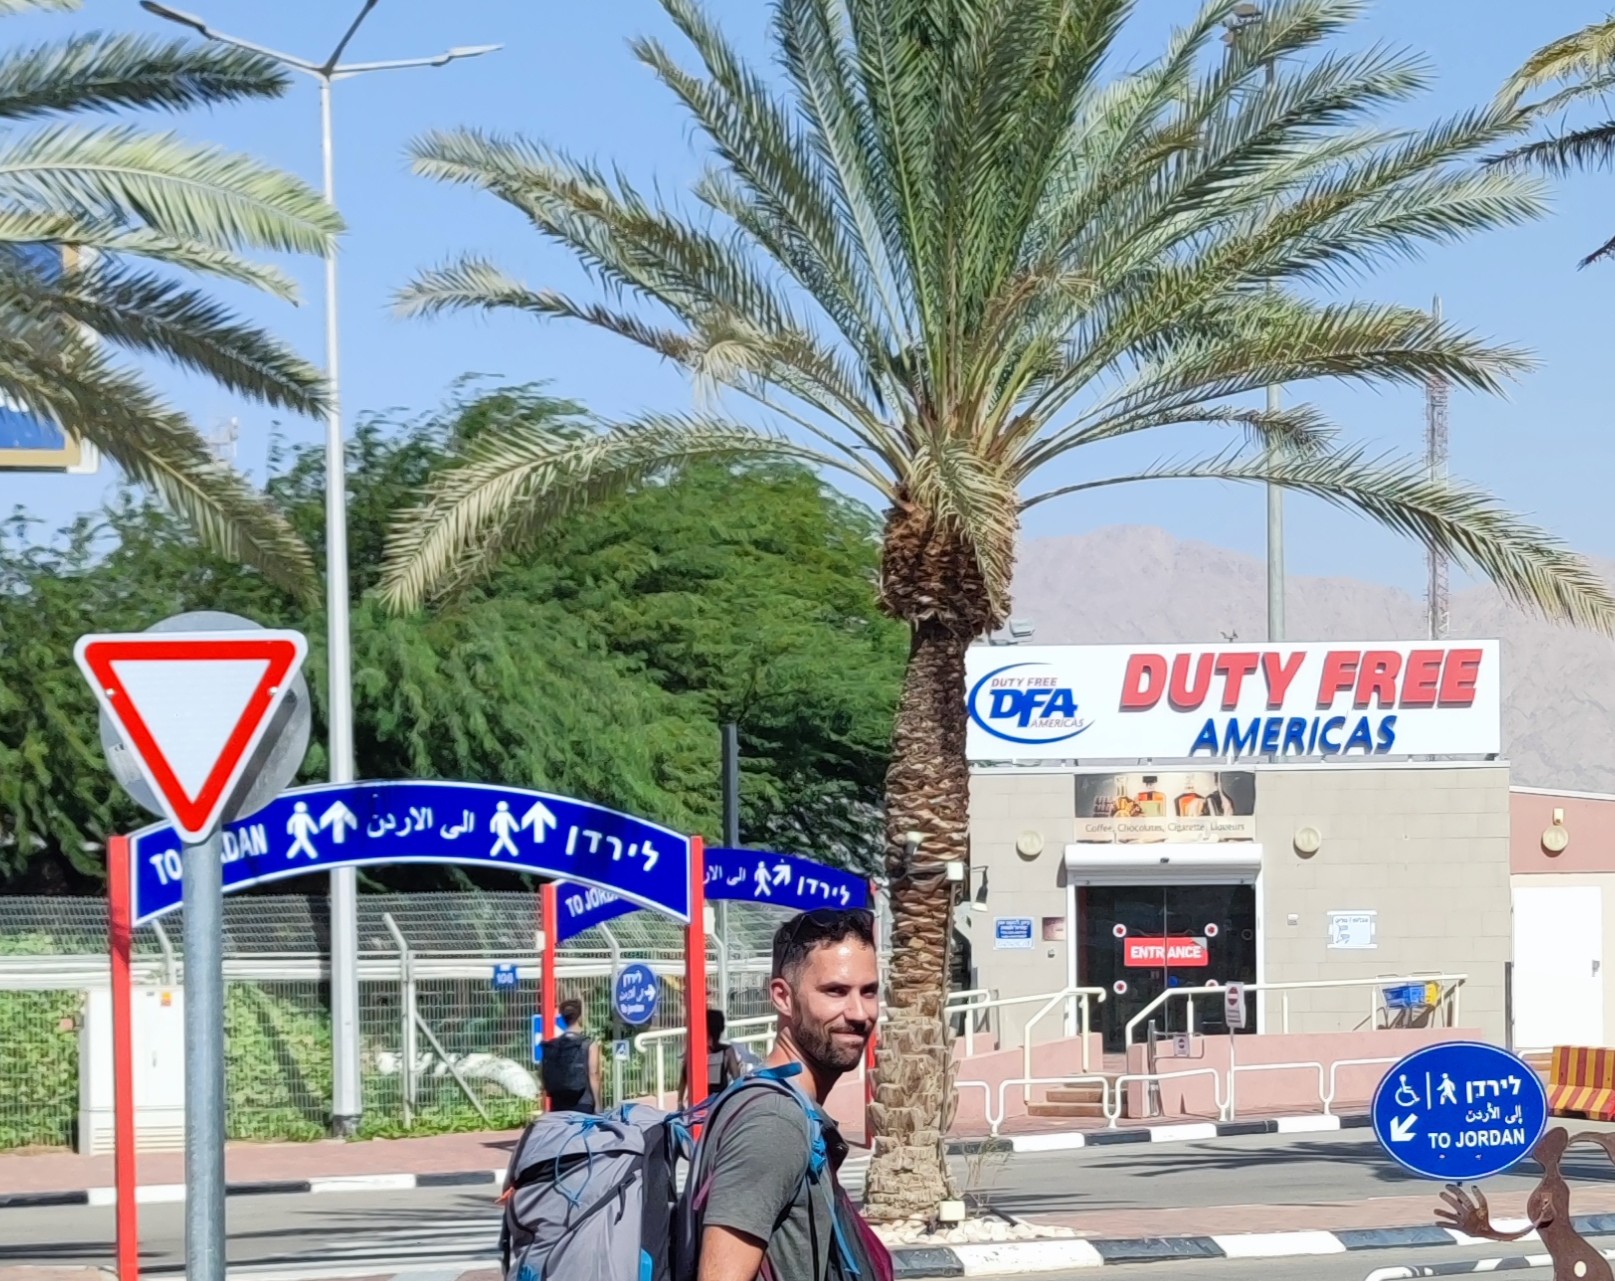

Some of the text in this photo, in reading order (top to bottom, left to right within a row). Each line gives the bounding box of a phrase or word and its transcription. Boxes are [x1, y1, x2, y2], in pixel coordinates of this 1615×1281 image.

[991, 677, 1058, 688] DUTY FREE
[1118, 648, 1484, 713] DUTY FREE
[988, 688, 1079, 728] DFA
[1030, 718, 1085, 729] AMERICAS
[1190, 715, 1397, 757] AMERICAS
[149, 822, 269, 886] TO DAN
[564, 824, 660, 873] לירדן
[564, 894, 585, 918] TO
[796, 875, 850, 907] לירדן
[1130, 945, 1202, 959] ENTRANCE
[1465, 1074, 1523, 1104] לירדן
[1427, 1127, 1526, 1150] TO JORDAN
